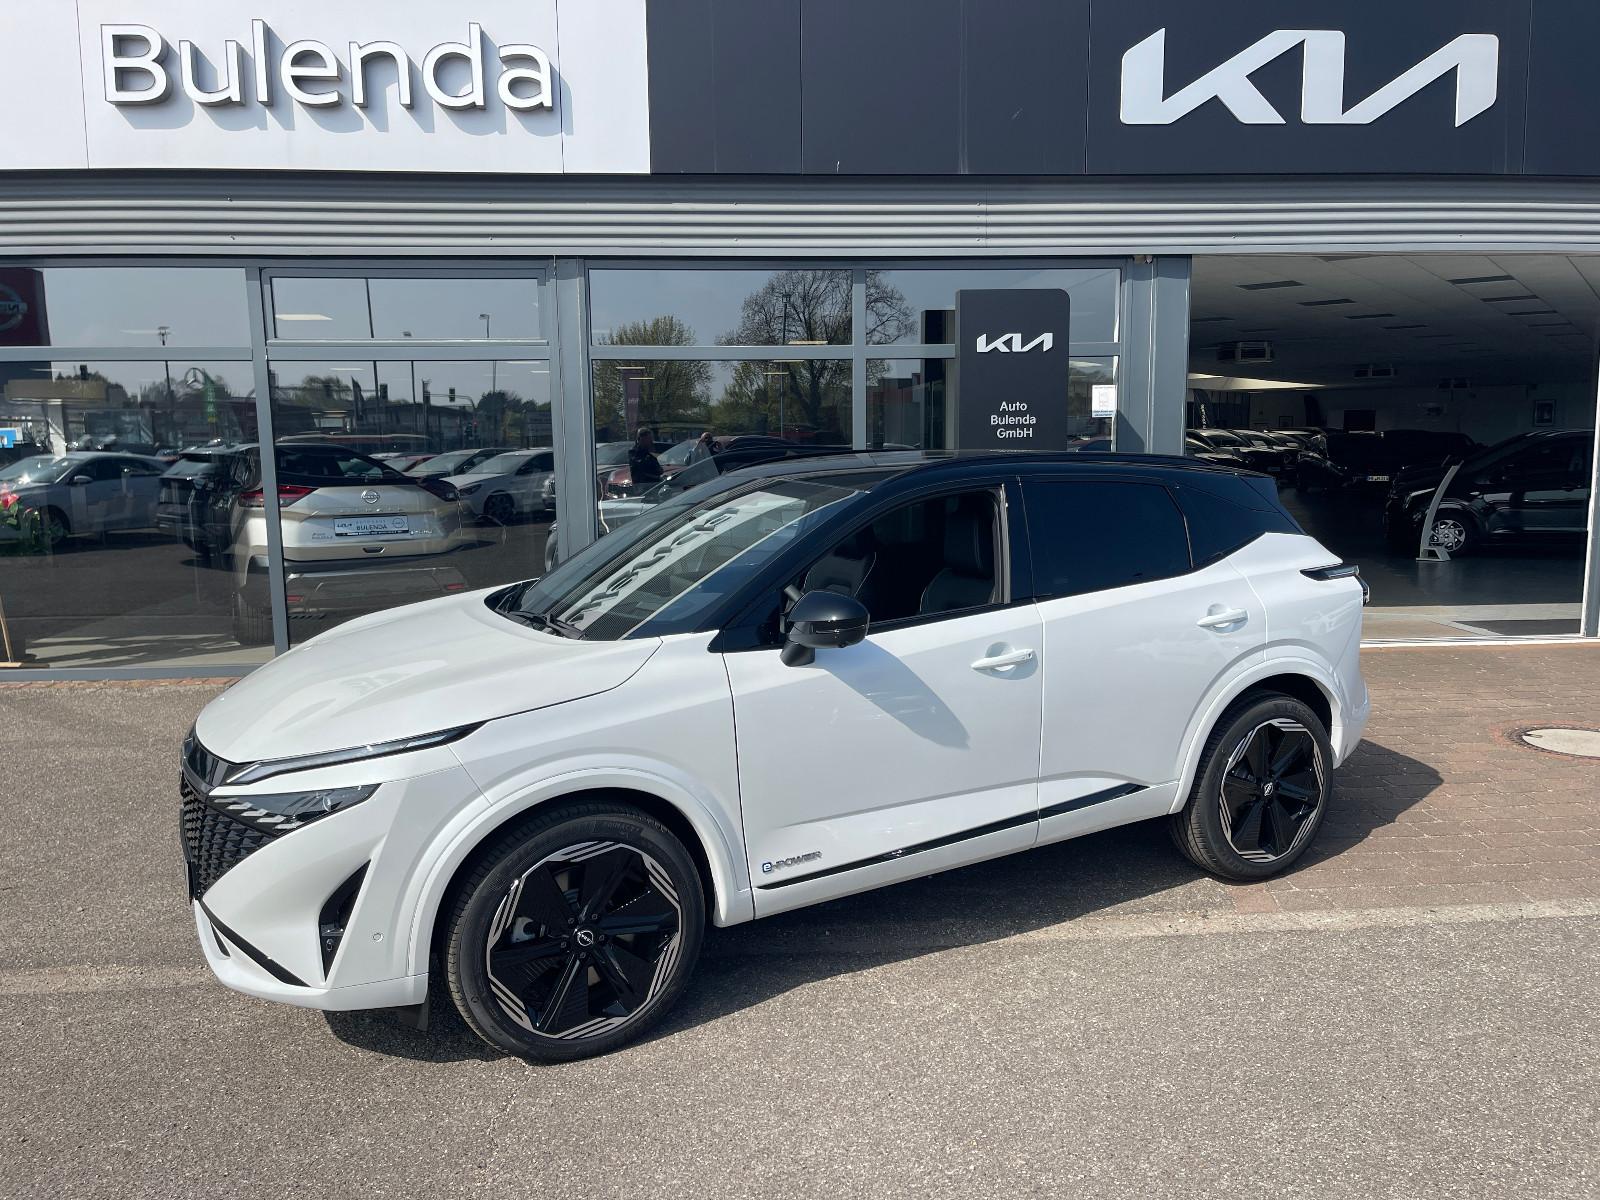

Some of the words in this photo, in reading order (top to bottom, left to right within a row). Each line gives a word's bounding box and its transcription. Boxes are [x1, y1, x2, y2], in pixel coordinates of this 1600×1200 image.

[100, 19, 553, 110] Bulenda
[1119, 27, 1499, 128] KIA
[976, 332, 1053, 353] KIA
[999, 401, 1028, 411] Auto
[990, 414, 1037, 425] Bulenda
[996, 427, 1033, 438] GmbH
